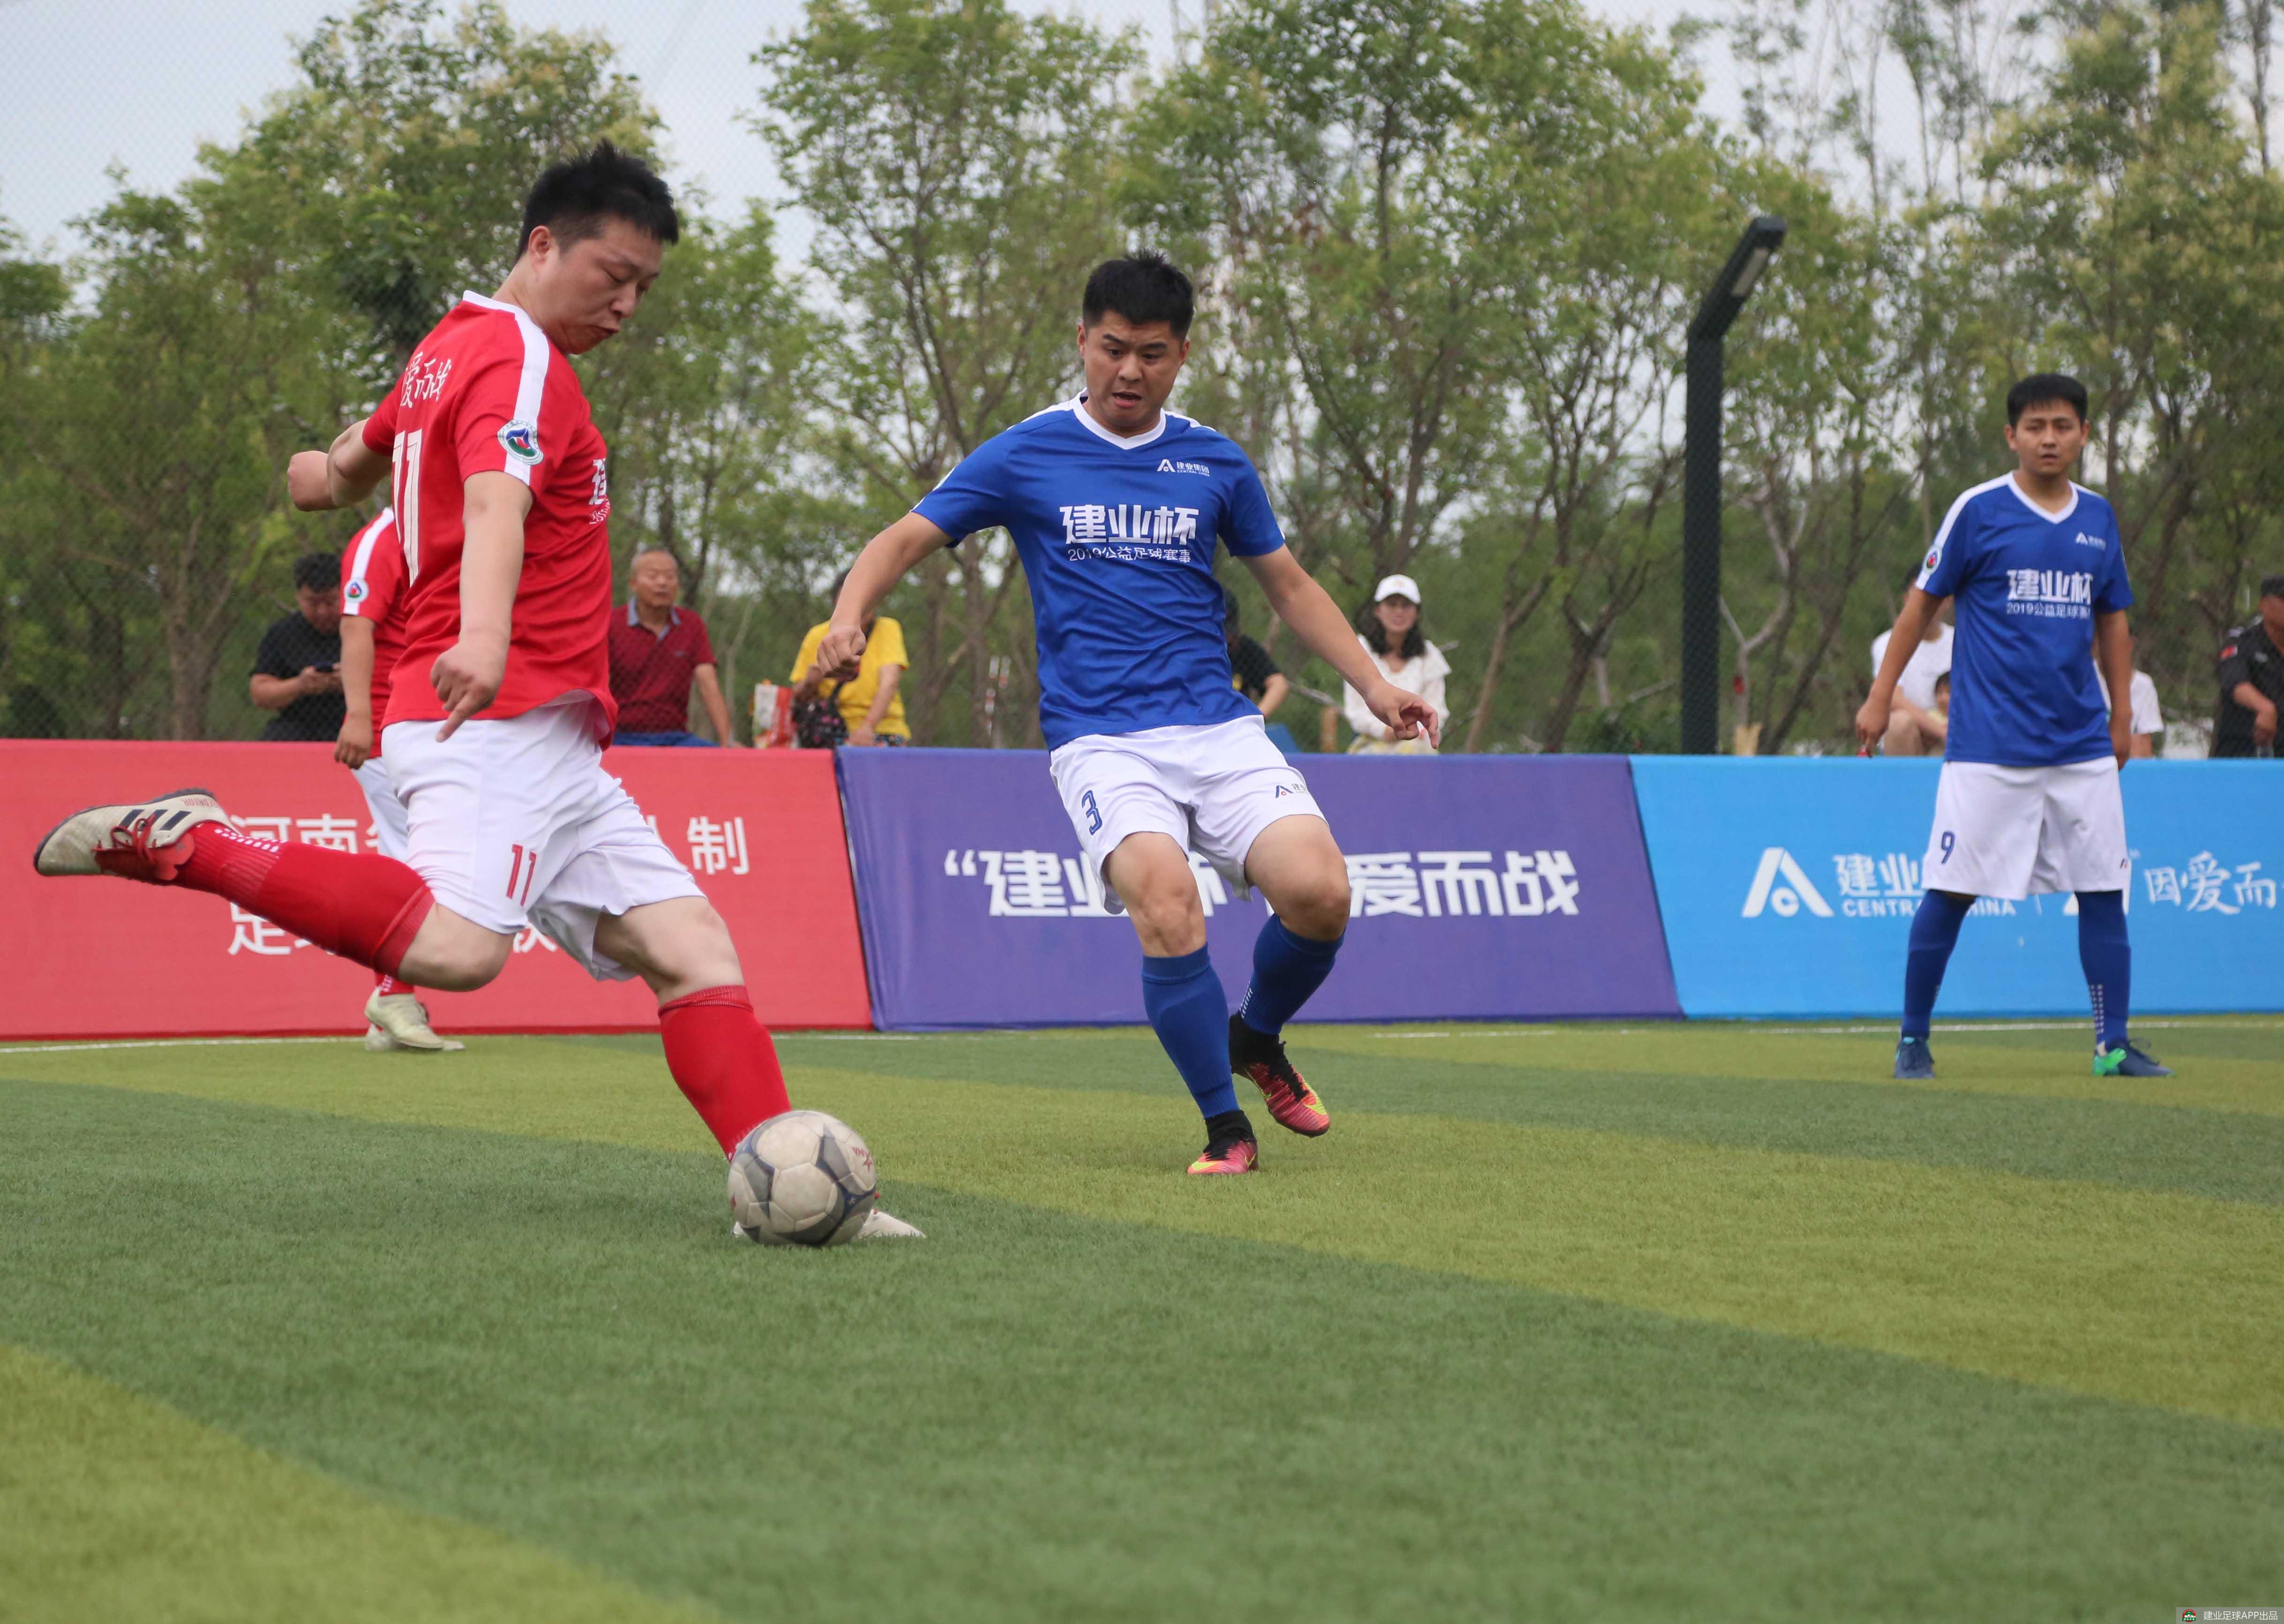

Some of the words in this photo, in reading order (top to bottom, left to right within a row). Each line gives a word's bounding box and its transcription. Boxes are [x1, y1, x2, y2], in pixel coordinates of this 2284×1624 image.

[392, 428, 422, 587] 11
[1059, 504, 1199, 545] 建业杯
[1068, 546, 1191, 564] 2019公益足球赛事
[2006, 569, 2094, 605] 建业杯
[1081, 789, 1103, 836] 3
[1941, 831, 1955, 864] 9
[506, 843, 537, 907] 11
[2144, 850, 2284, 915] 因爱而
[1842, 898, 1921, 917] CENTR
